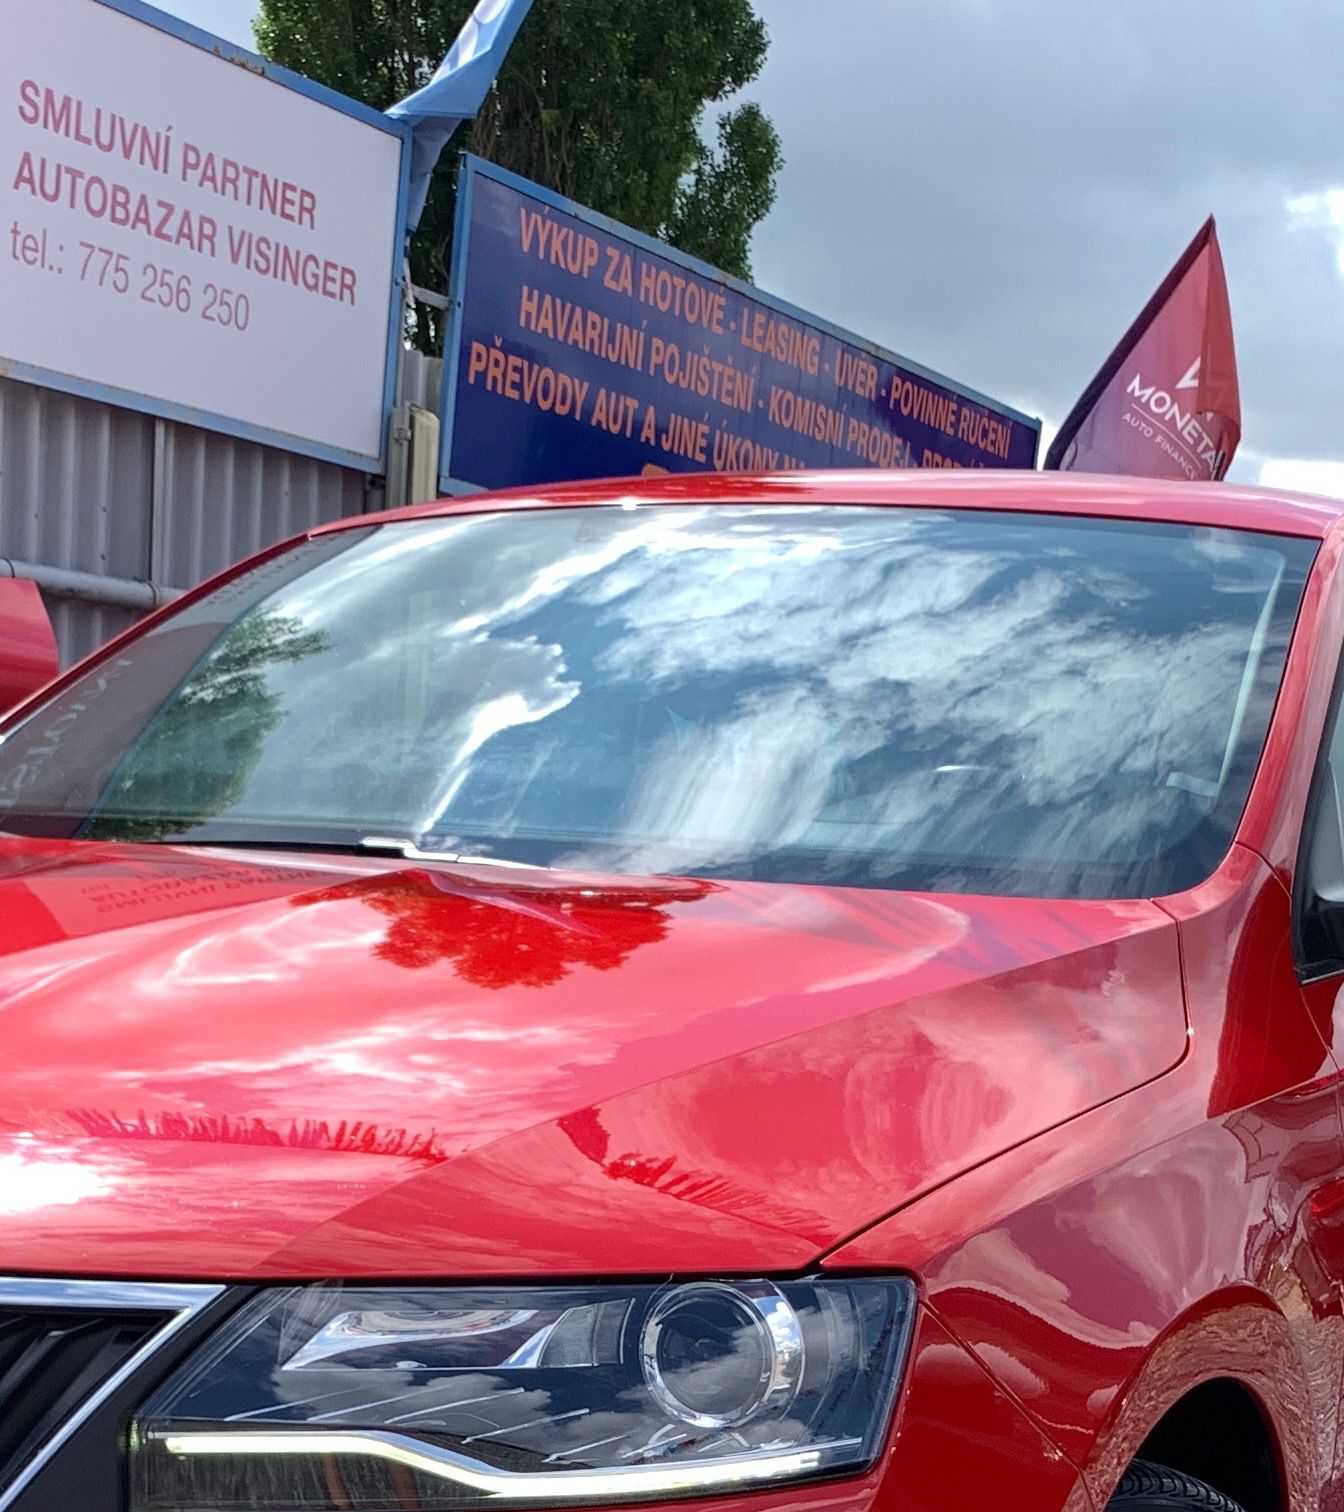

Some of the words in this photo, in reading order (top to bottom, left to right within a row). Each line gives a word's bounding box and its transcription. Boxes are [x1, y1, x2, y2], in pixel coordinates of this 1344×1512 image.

[13, 151, 217, 258] AUTOBAZAR
[228, 225, 356, 305] VISINGER
[18, 79, 174, 174] SMLUVNÍ
[181, 142, 316, 230] PARTNER
[10, 221, 63, 274] tel.:
[80, 241, 129, 293] 775
[140, 264, 191, 313] 256
[201, 283, 250, 331] 250
[520, 205, 599, 278] VÝKUP
[603, 246, 633, 297] ZA
[639, 262, 726, 335] HOTOVÉ
[740, 307, 820, 376] LEASING
[958, 407, 1013, 459] RUČENÍ
[468, 335, 589, 421] PŘEVODY
[591, 388, 639, 438] AUT
[640, 405, 656, 446] A
[661, 413, 710, 463] JINÉ
[519, 285, 647, 372] HAVARIJNÍ
[649, 337, 756, 413] POJIŠTĚNÍ
[768, 385, 848, 448] KOMISNÍ
[1122, 412, 1154, 437] AUTO
